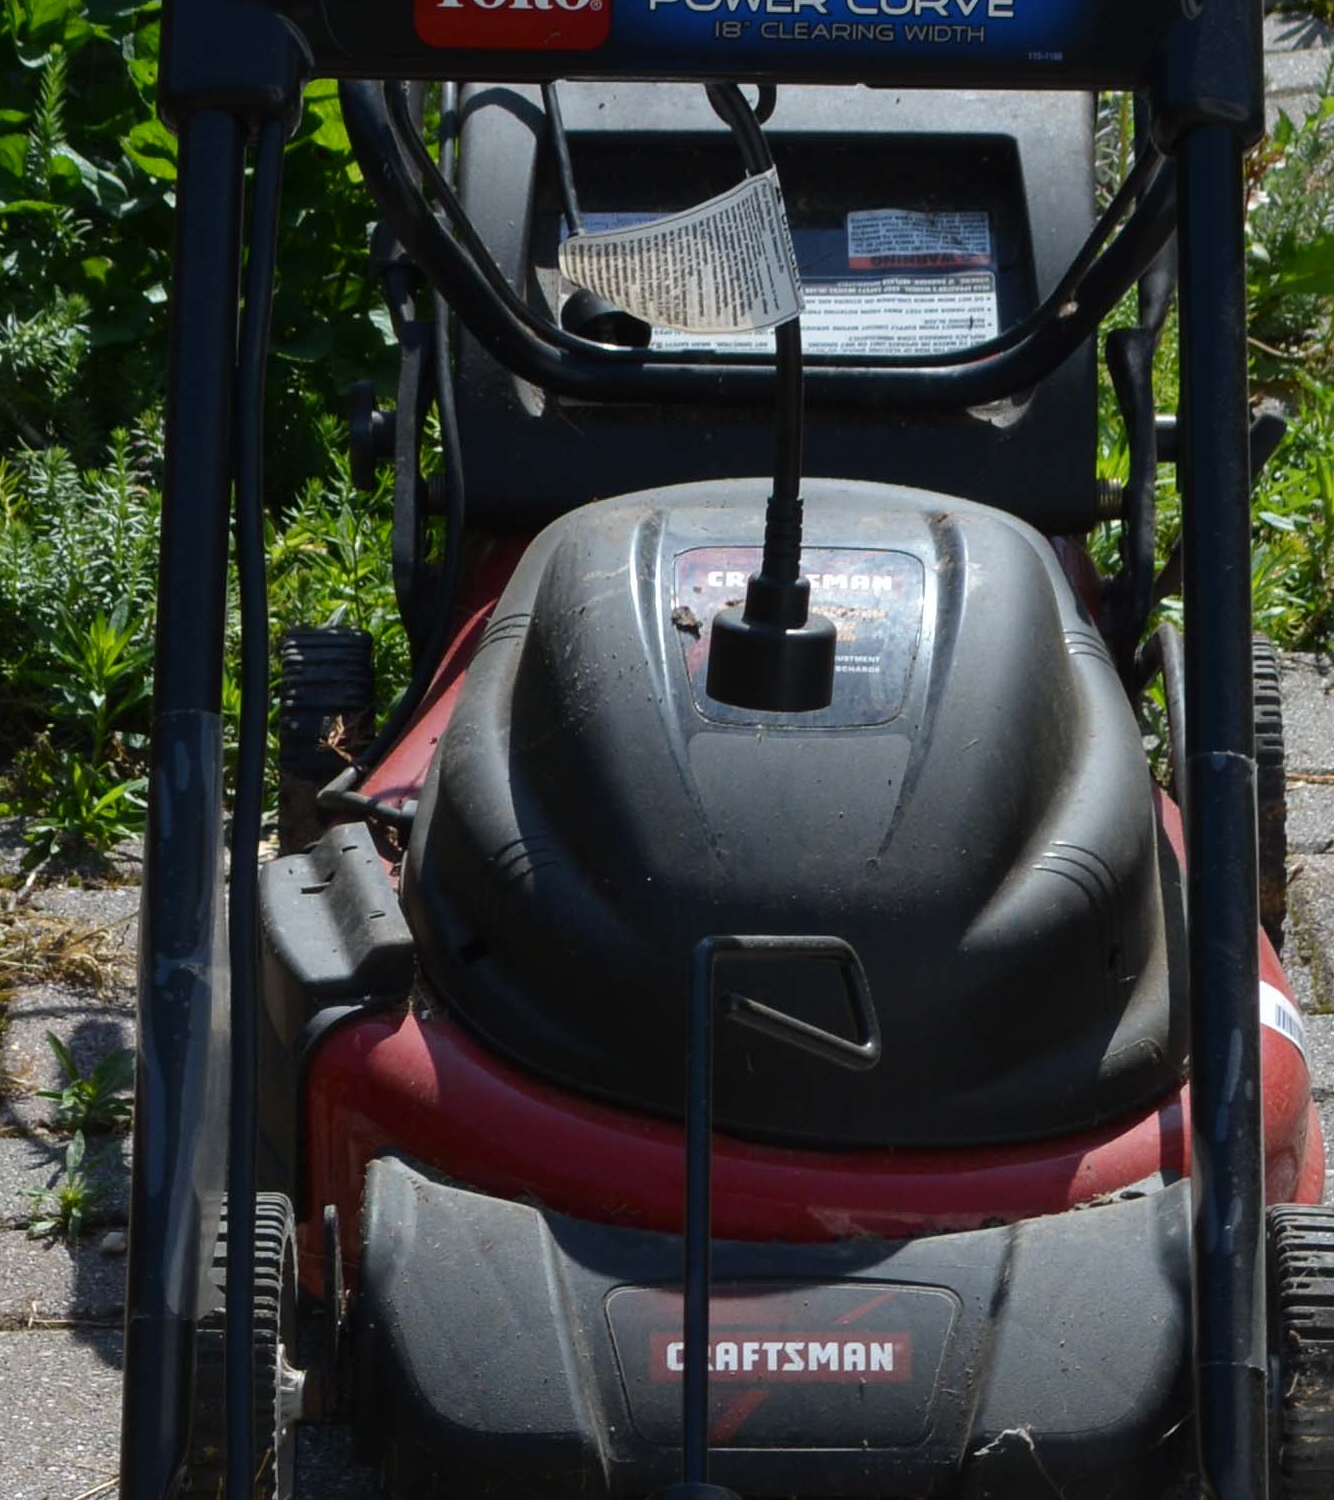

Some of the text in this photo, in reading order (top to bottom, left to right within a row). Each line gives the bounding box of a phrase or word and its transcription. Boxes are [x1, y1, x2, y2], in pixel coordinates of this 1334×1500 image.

[761, 21, 895, 42] CLEARING
[904, 24, 985, 43] WIDTH
[666, 1340, 894, 1372] CAFTSMAN
